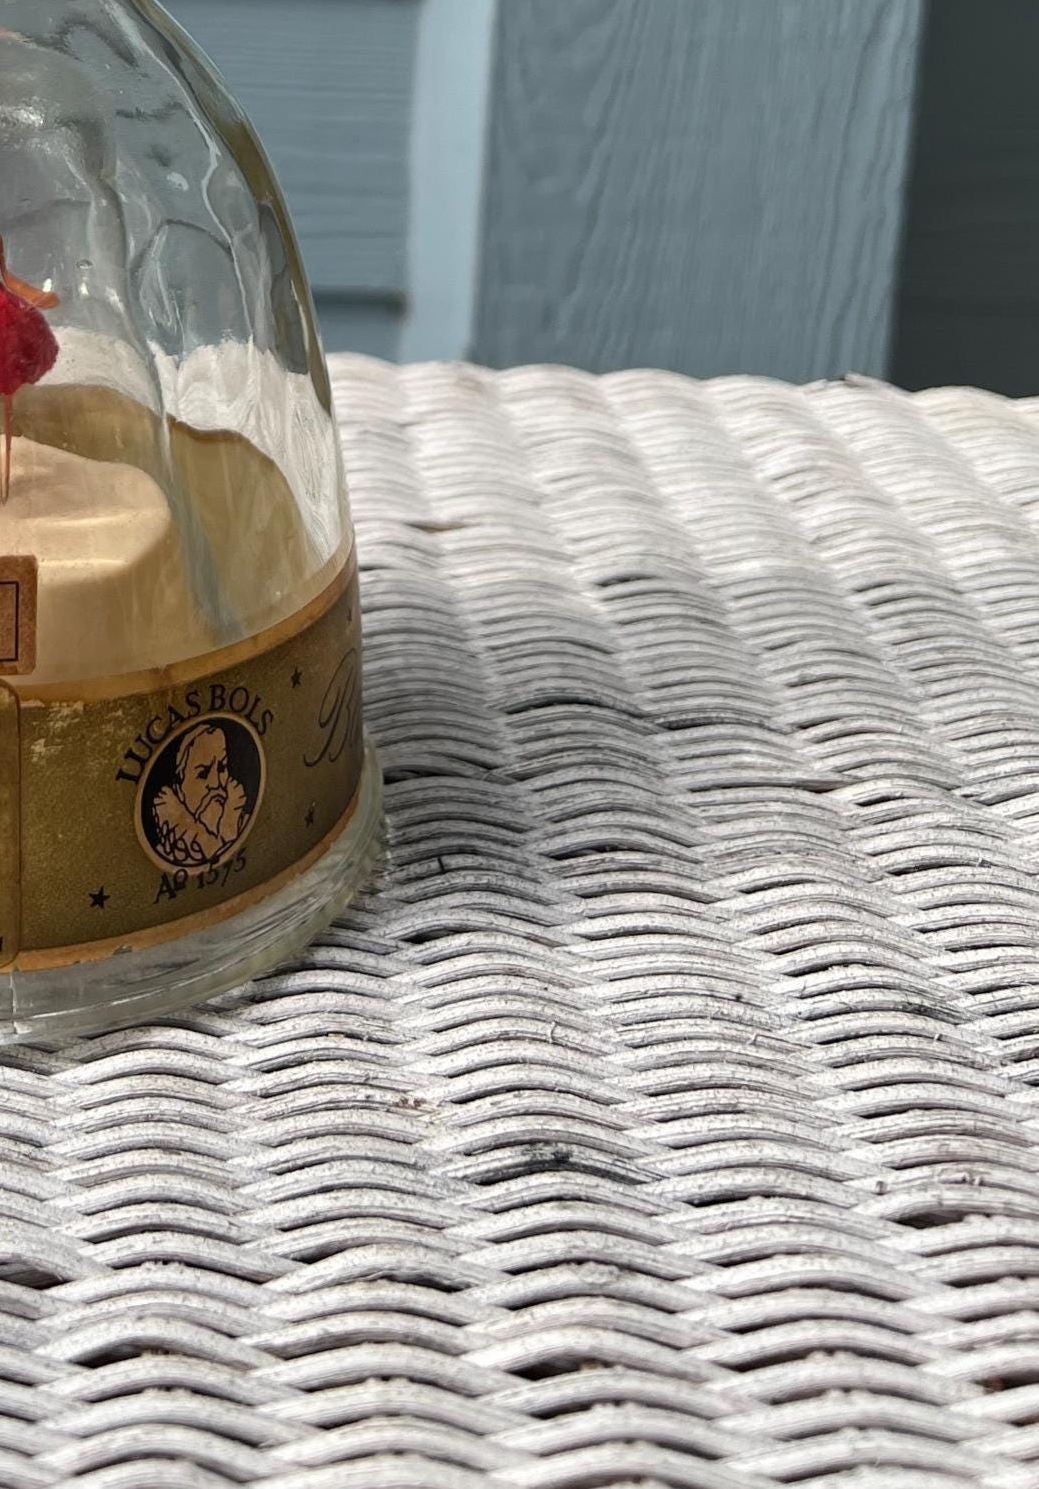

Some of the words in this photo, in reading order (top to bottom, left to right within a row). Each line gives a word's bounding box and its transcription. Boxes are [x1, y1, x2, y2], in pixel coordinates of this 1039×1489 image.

[115, 689, 203, 786] LUCAS
[208, 683, 274, 737] BOLS
[196, 847, 248, 890] 1575
